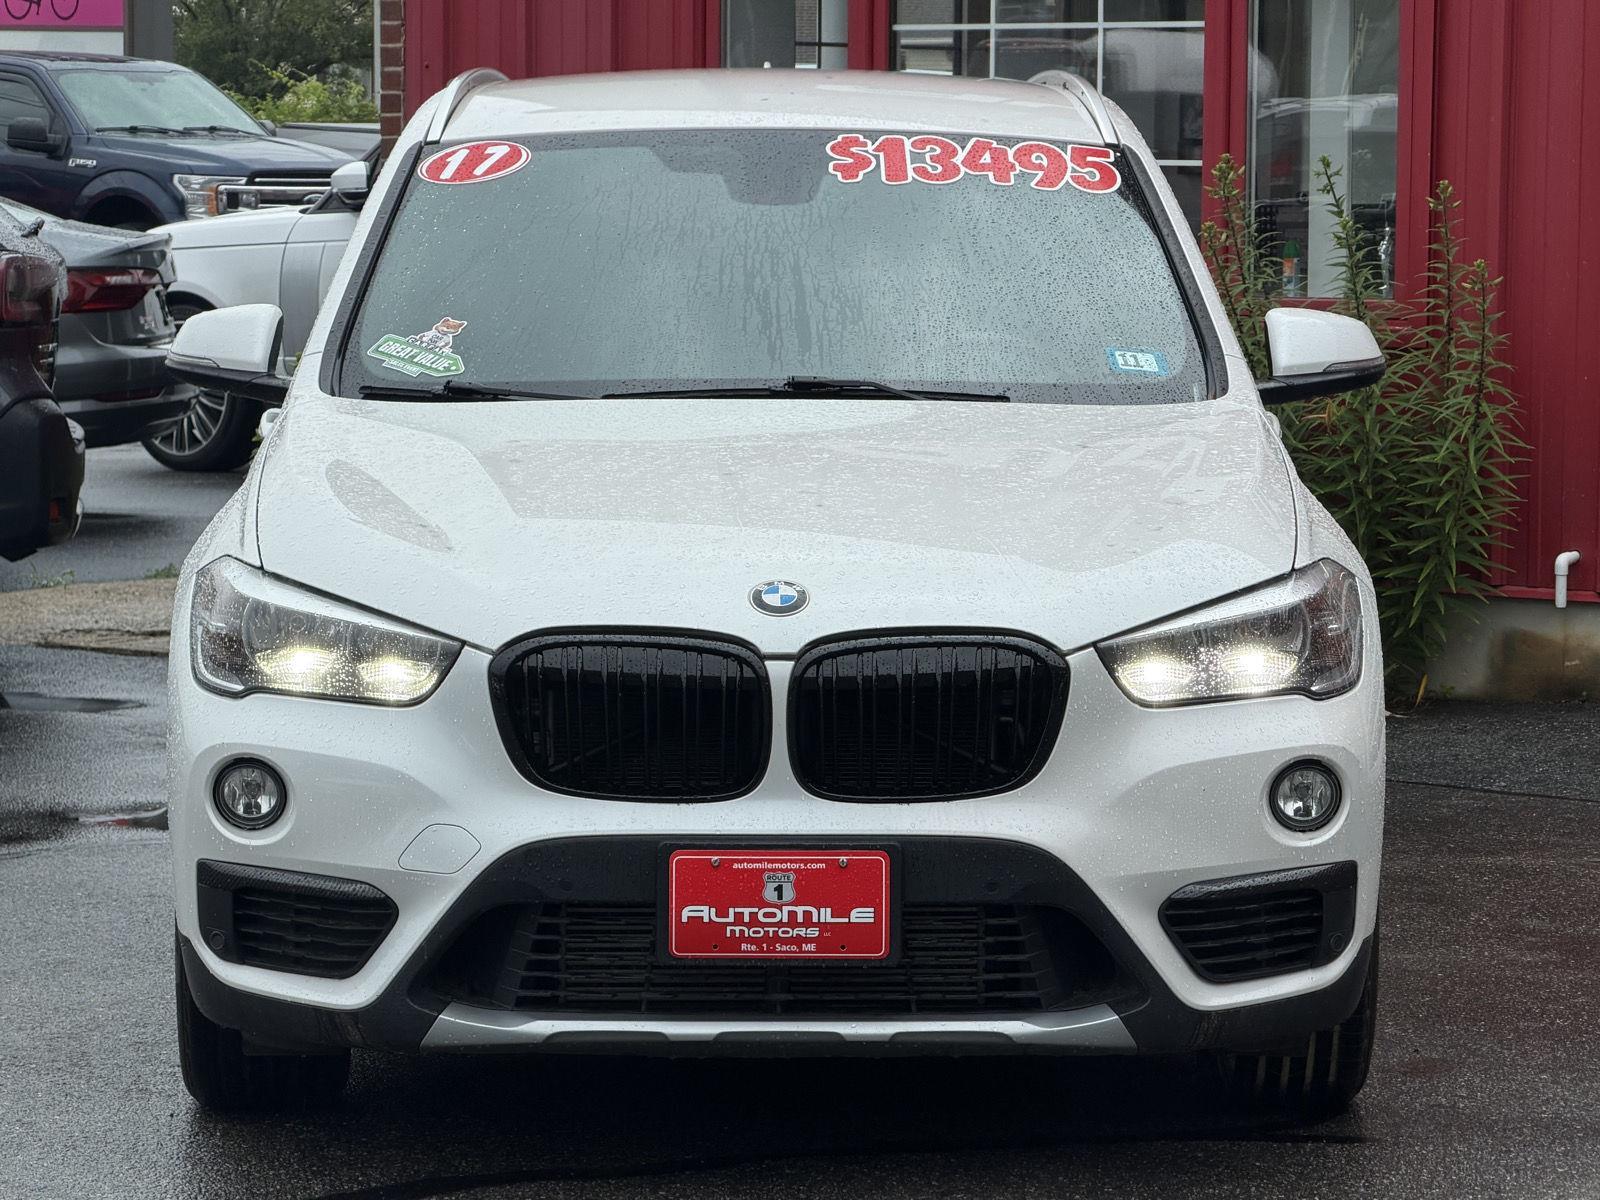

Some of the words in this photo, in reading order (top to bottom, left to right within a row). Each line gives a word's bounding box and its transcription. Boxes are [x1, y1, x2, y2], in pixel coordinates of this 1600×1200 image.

[440, 145, 511, 180] 17
[826, 134, 1122, 194] $13495
[378, 341, 420, 359] GREAT
[413, 351, 453, 371] VALUE
[732, 862, 826, 870] automilemotors.com
[773, 883, 784, 901] 1
[726, 926, 820, 938] MOTORS
[741, 943, 760, 952] Rte.
[762, 943, 767, 952] 1
[775, 943, 799, 953] Saco,
[802, 943, 817, 952] ME
